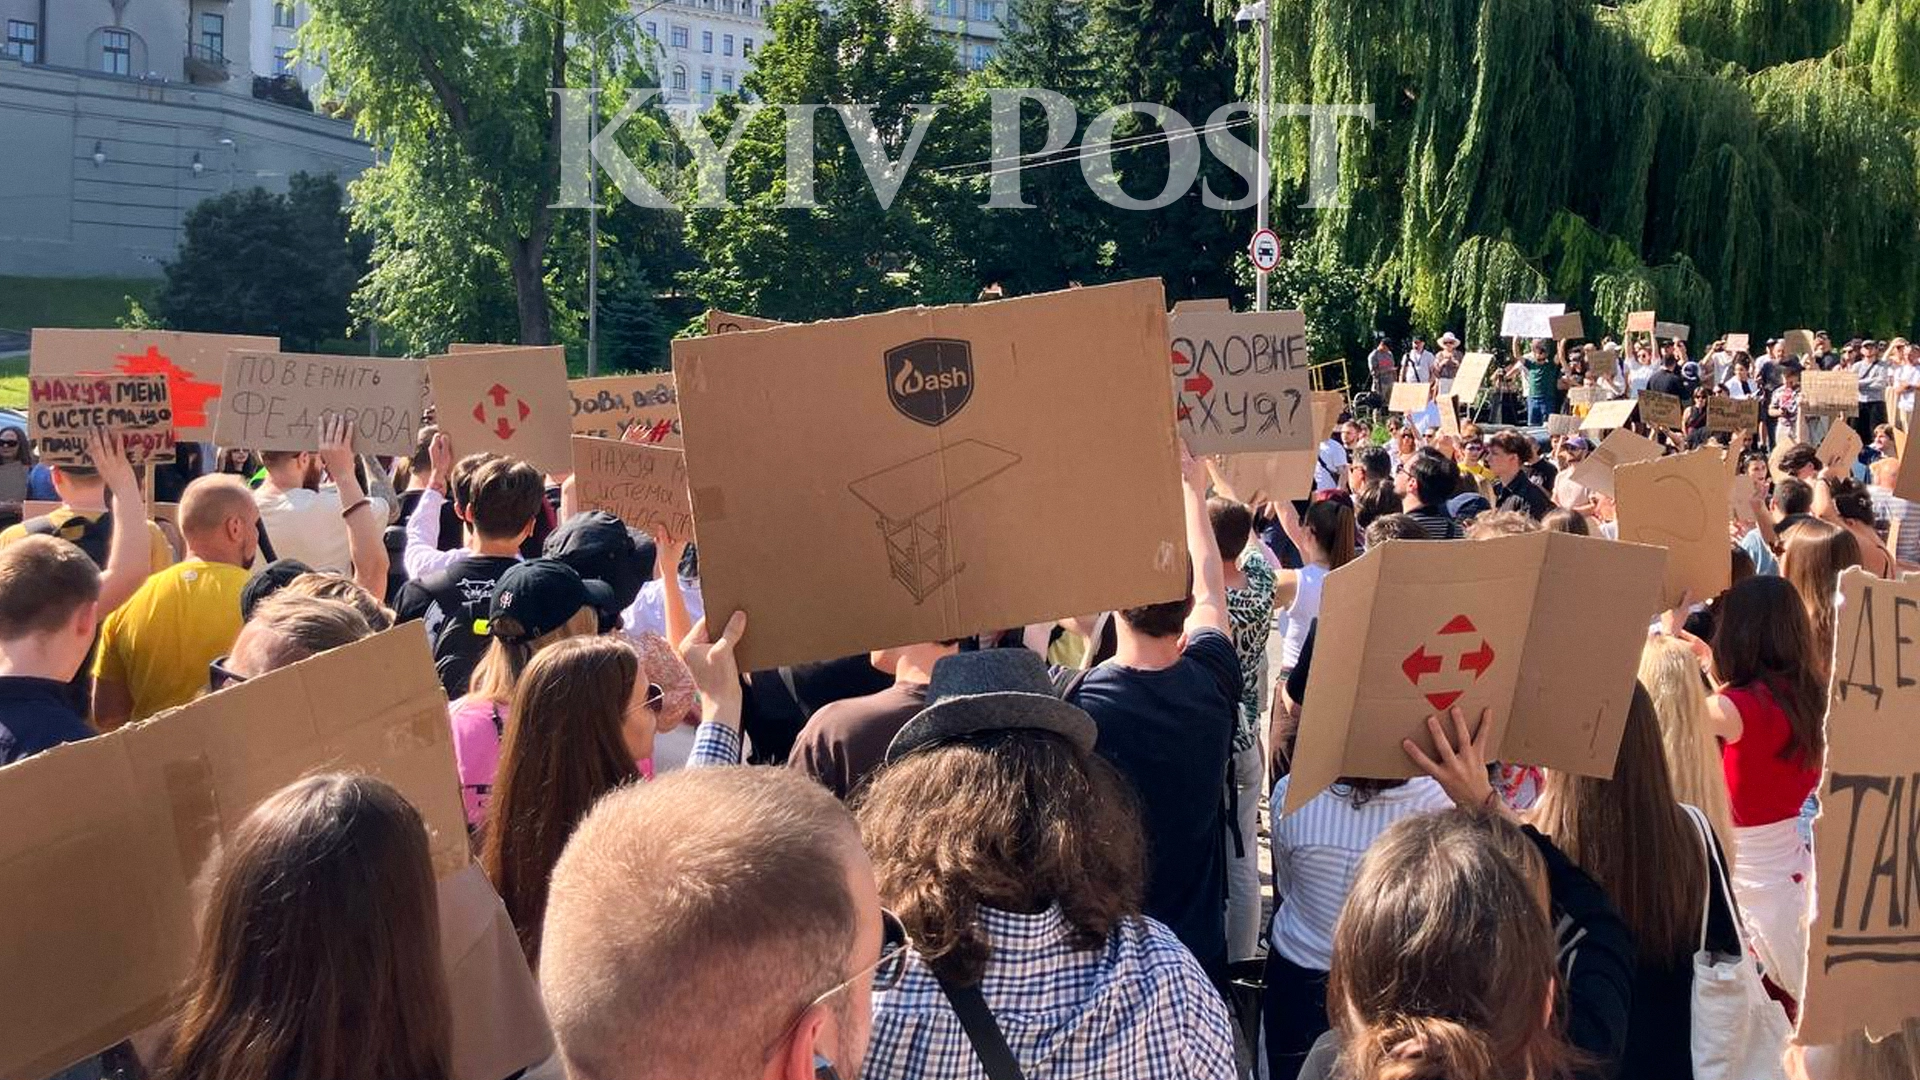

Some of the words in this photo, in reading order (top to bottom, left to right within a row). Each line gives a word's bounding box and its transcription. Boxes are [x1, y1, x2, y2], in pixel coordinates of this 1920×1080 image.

[30, 378, 112, 404] НАХУЯ
[116, 375, 167, 402] МЕНІ
[895, 358, 968, 397] Dash
